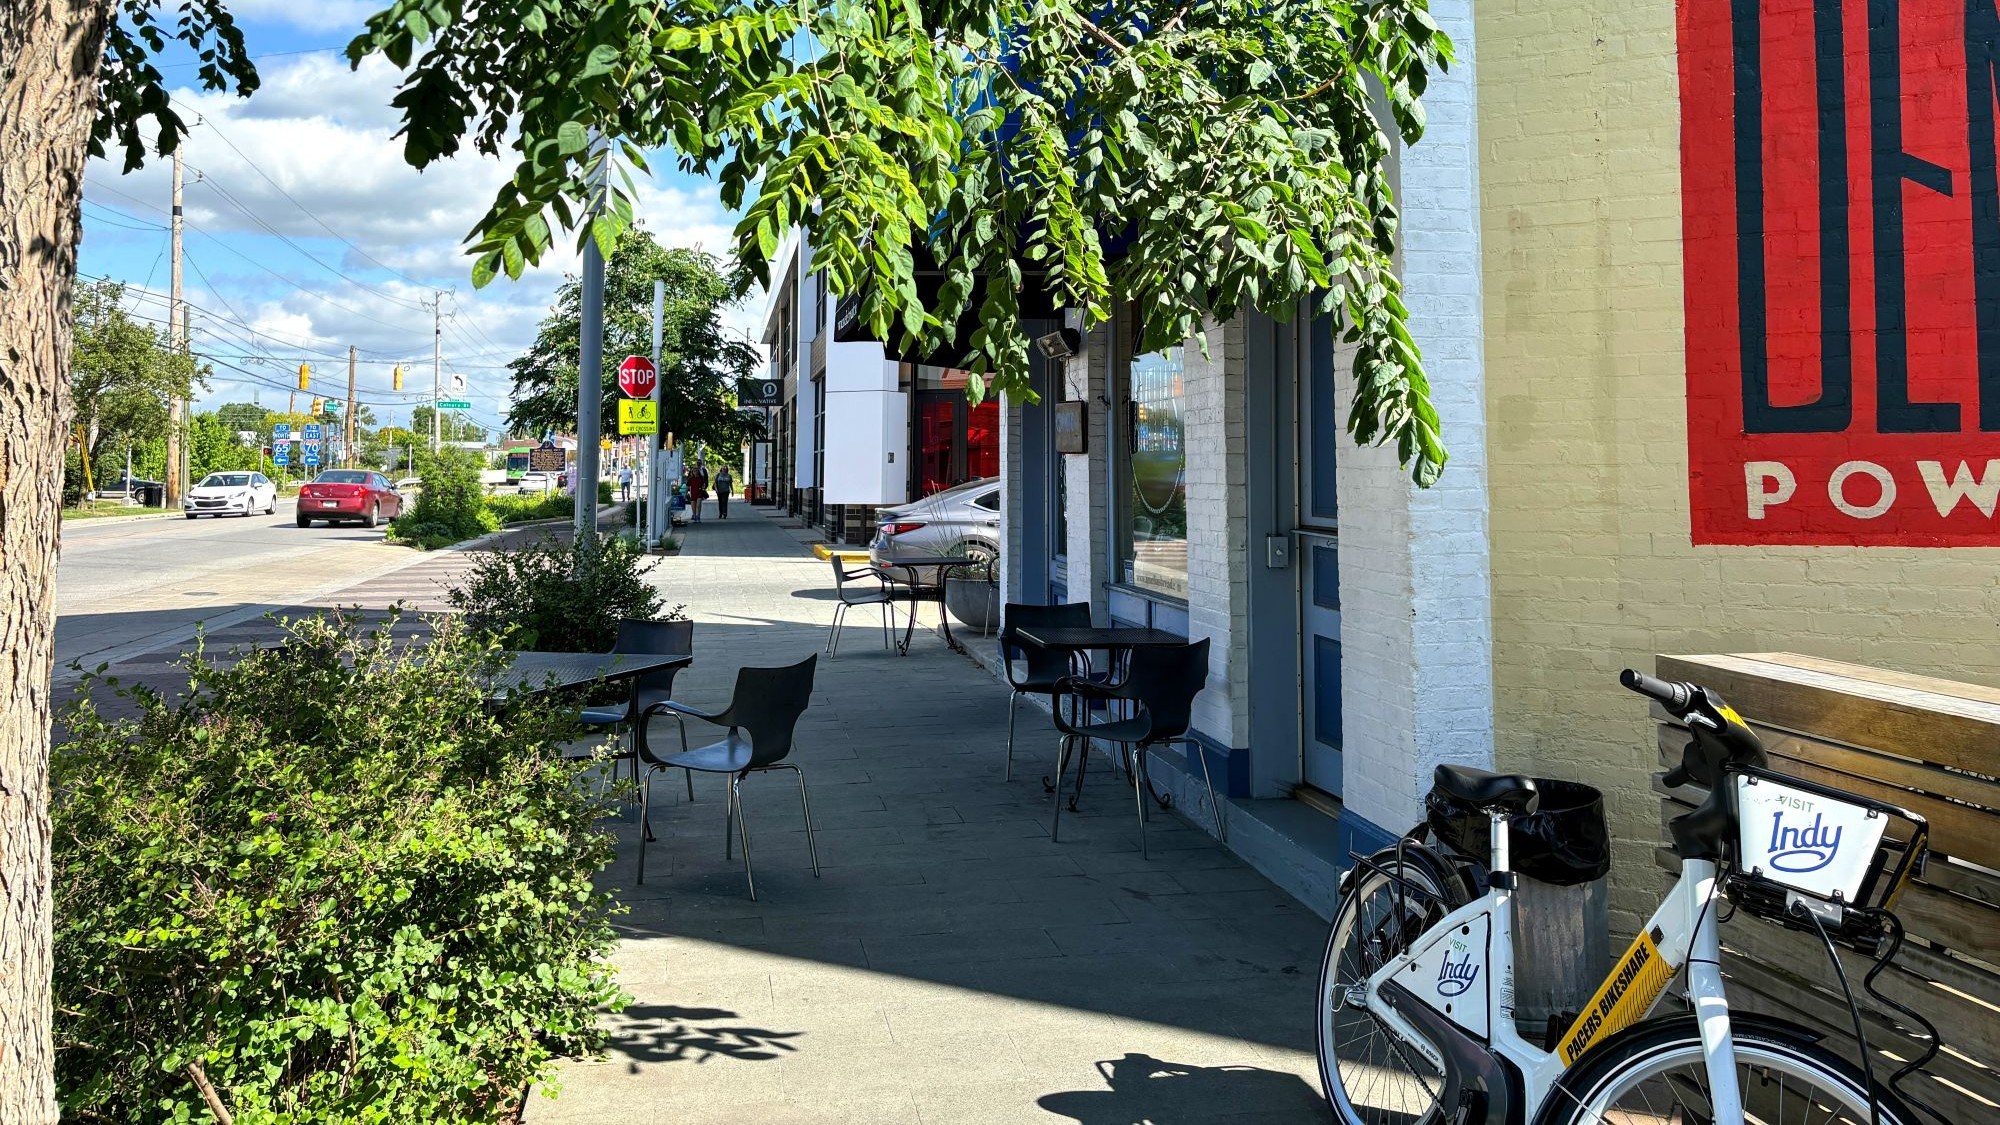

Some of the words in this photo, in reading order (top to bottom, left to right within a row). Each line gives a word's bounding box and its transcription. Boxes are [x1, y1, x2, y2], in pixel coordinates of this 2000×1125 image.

[621, 368, 654, 385] STOP
[276, 443, 288, 452] 65
[306, 443, 318, 452] 70
[1779, 795, 1815, 812] VISIT
[1767, 811, 1843, 873] Indy
[1449, 938, 1467, 952] VISIT
[1437, 950, 1480, 997] Indy
[1566, 1008, 1603, 1063] PACERS
[1598, 942, 1651, 1018] BIKESHARE
